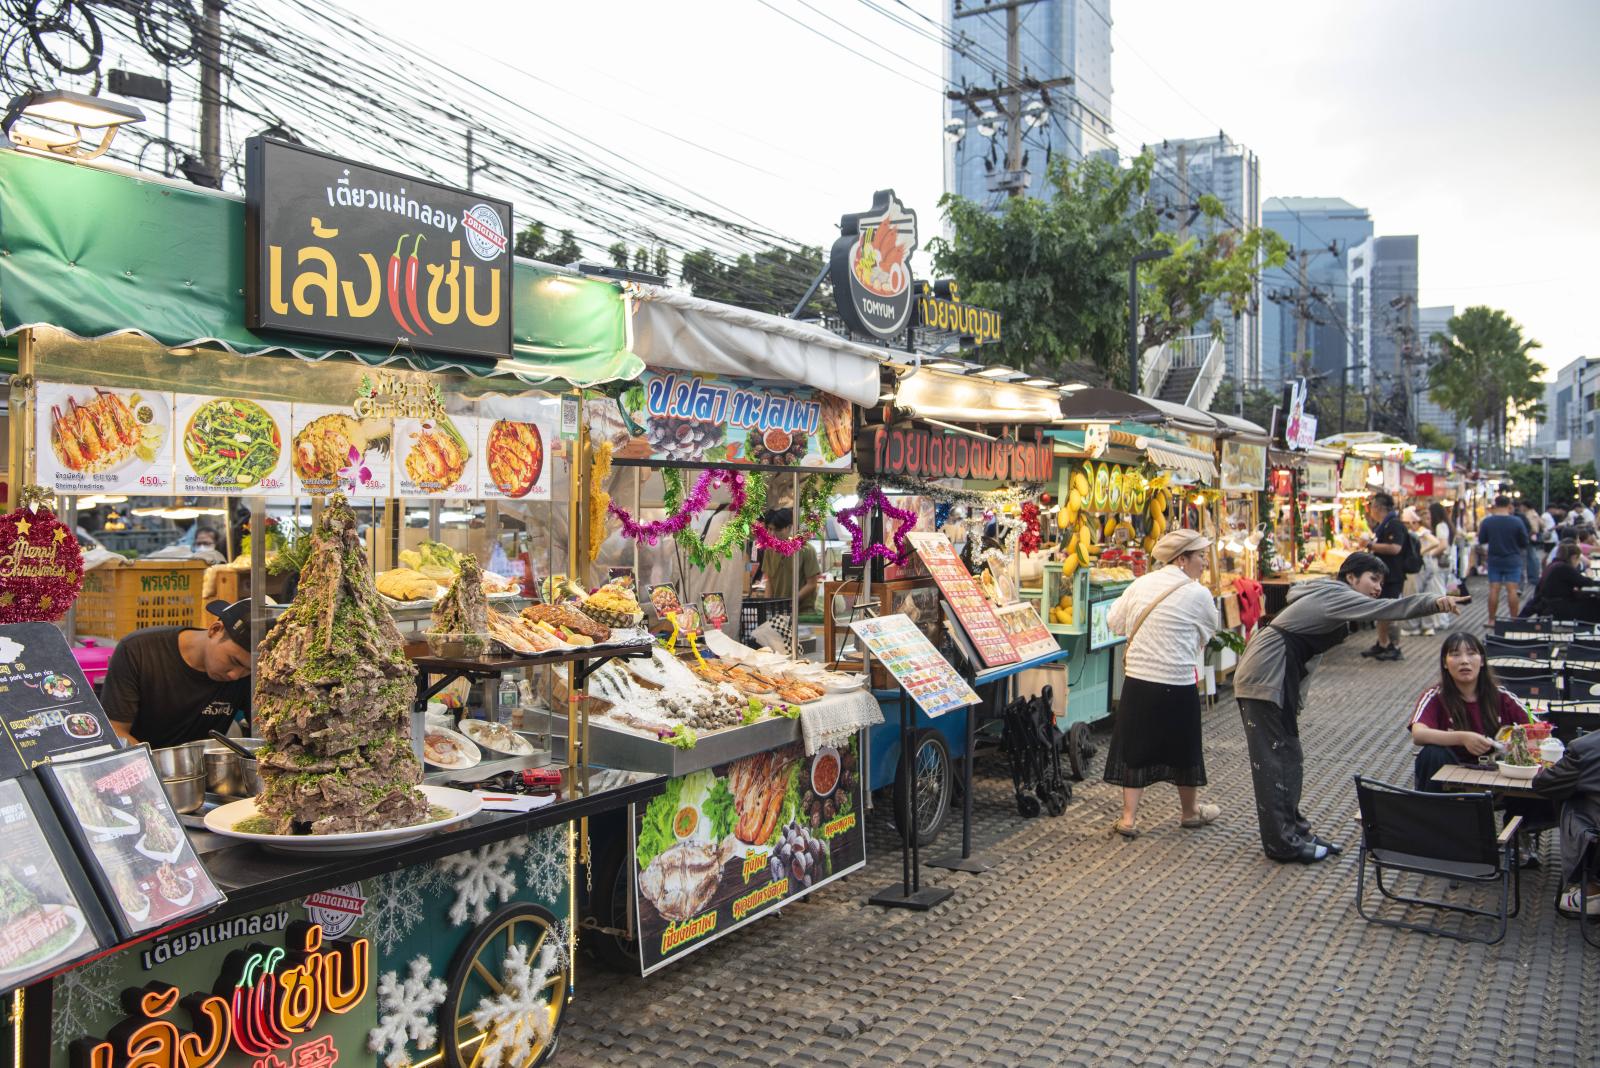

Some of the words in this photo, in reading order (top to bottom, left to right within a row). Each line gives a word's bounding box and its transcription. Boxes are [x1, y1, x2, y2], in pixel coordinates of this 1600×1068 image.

[468, 216, 502, 246] ORIGINAL
[862, 297, 895, 320] TOMYUM
[312, 892, 361, 911] ORIGINAL
